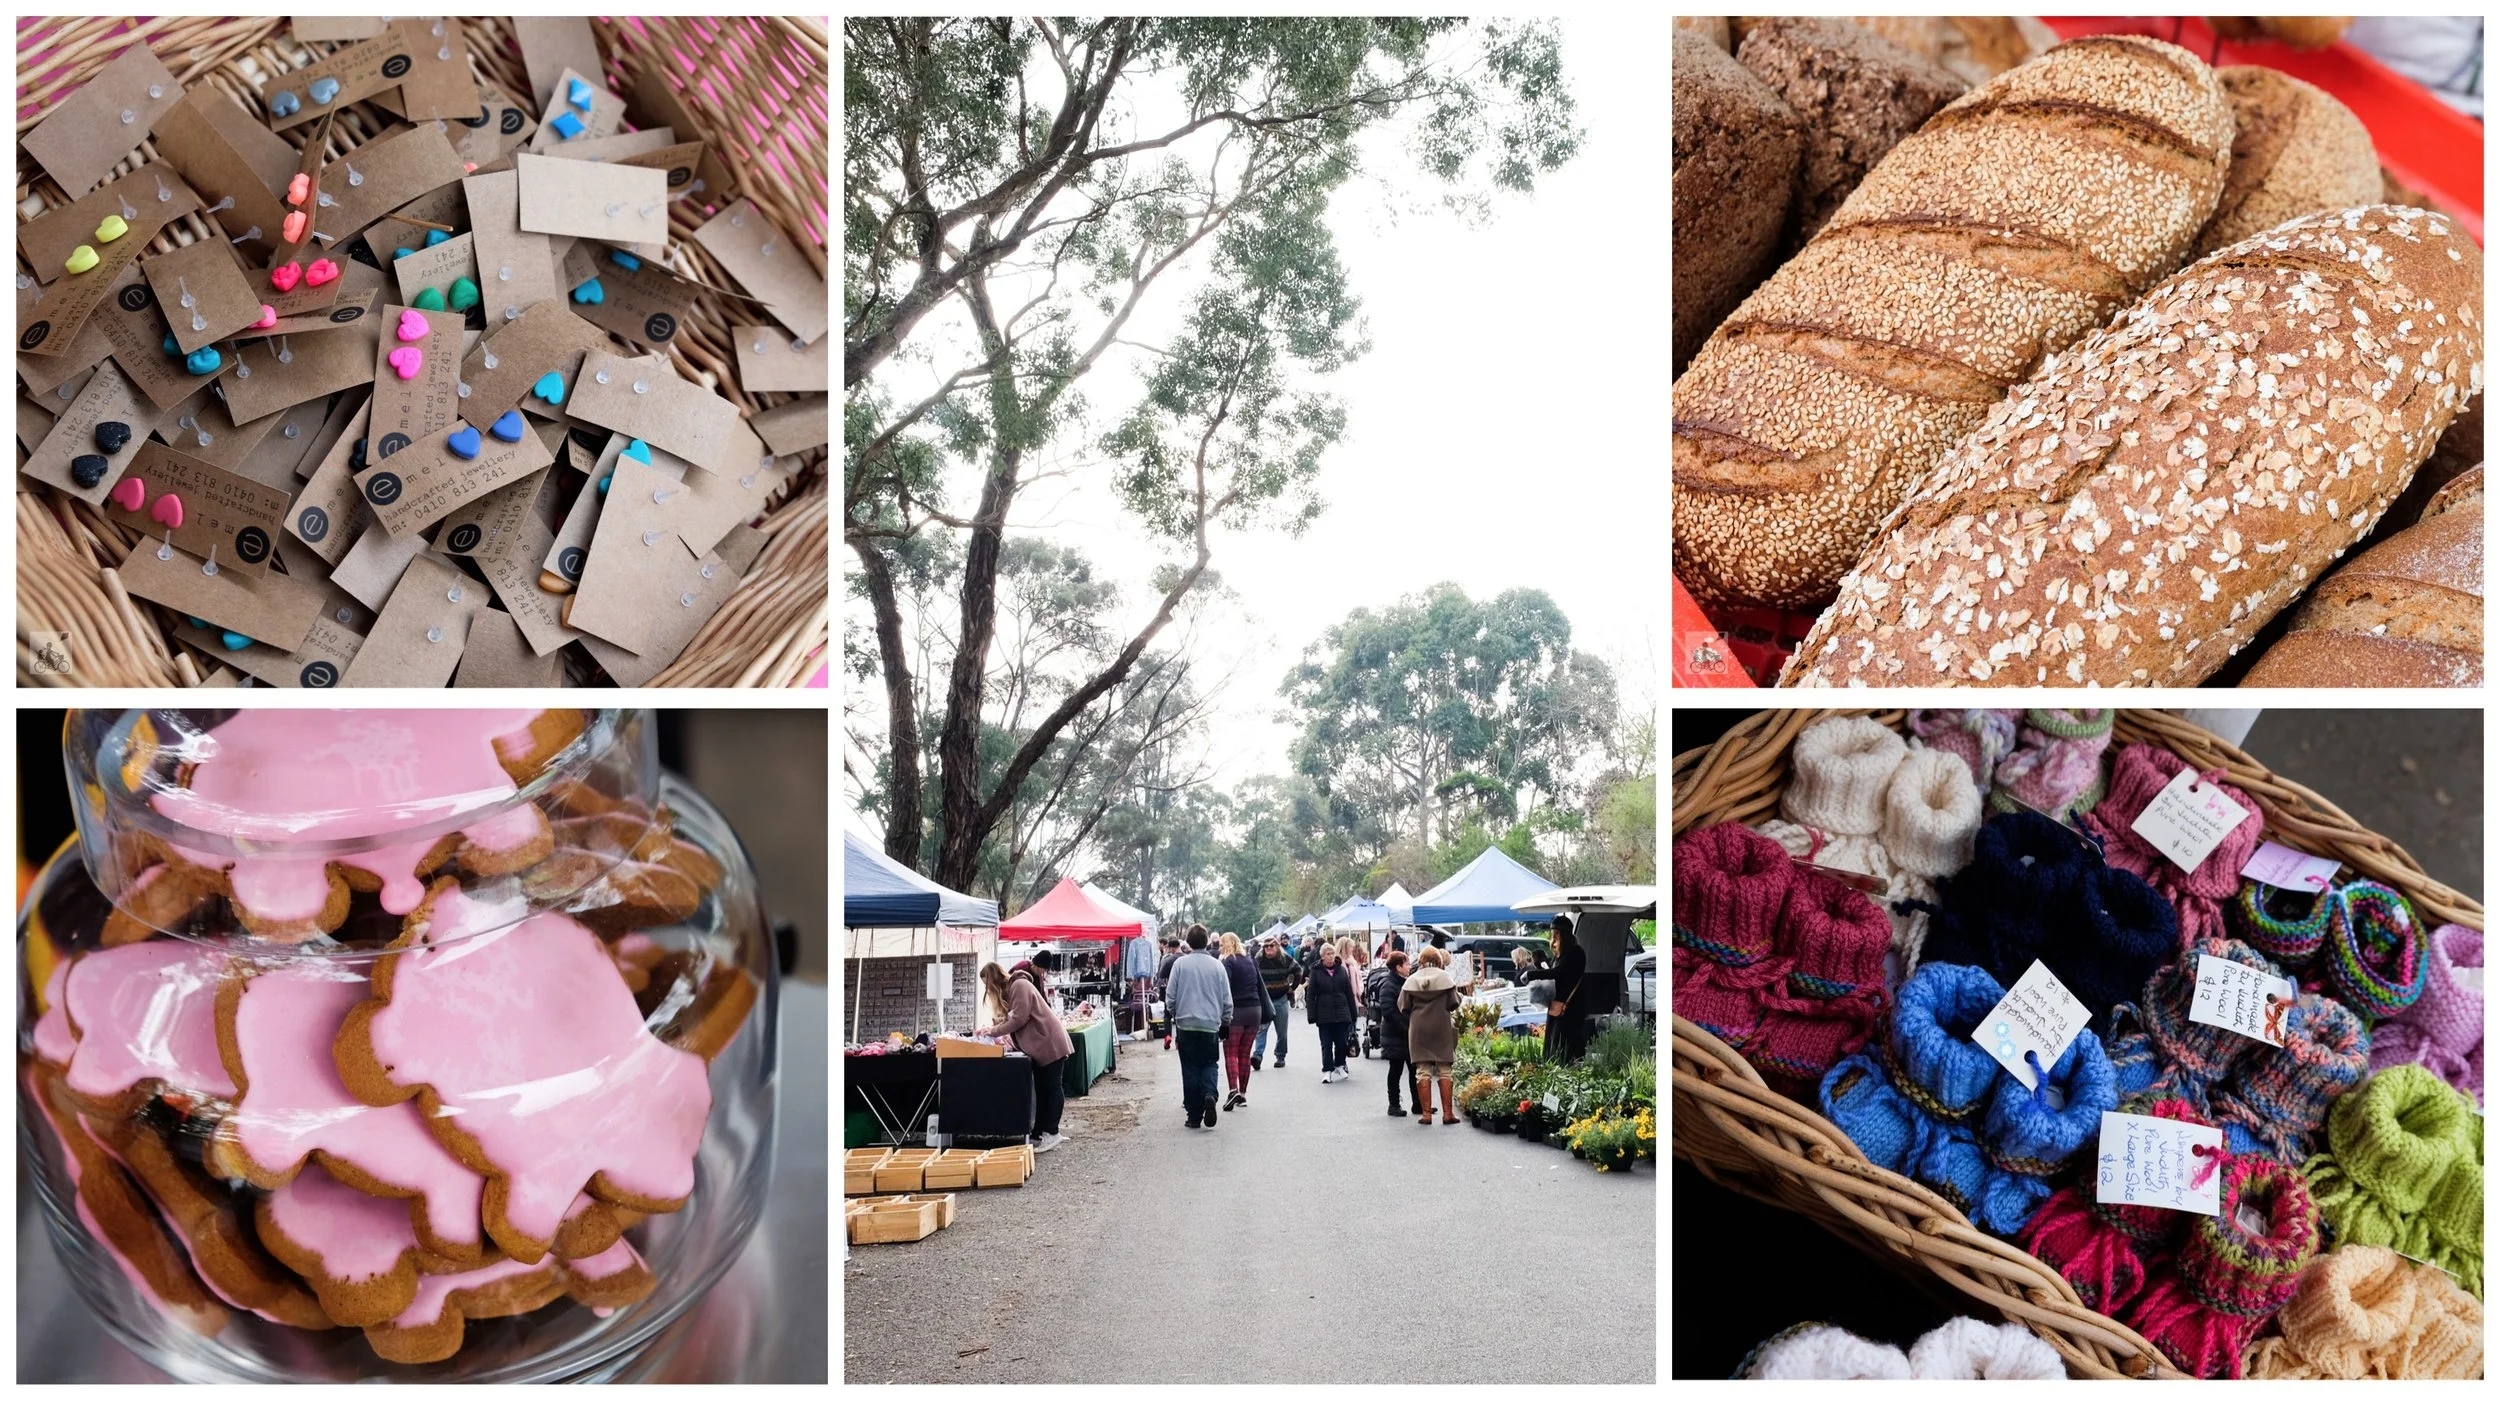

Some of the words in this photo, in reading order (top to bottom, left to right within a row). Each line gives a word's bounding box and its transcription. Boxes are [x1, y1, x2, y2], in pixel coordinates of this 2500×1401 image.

[435, 248, 455, 263] 241
[104, 324, 126, 348] 0410
[427, 331, 441, 388] jewellery
[441, 351, 452, 373] 241
[100, 369, 119, 389] 410
[438, 382, 448, 404] 813
[81, 393, 100, 413] 813
[62, 417, 82, 437] 241
[145, 465, 200, 495] jewellery
[166, 460, 188, 477] 241
[194, 472, 217, 488] 813
[224, 483, 255, 503] 0410
[383, 477, 455, 523] handcrafted
[460, 450, 516, 480] jewellery
[391, 521, 407, 534] m:
[415, 495, 446, 519] 0410
[452, 480, 477, 497] 813
[483, 467, 506, 482] 241
[205, 491, 276, 525] handcrafted
[503, 505, 521, 532] 0410
[520, 479, 534, 499] 813
[497, 568, 516, 590] 813
[514, 595, 533, 617] 241
[515, 577, 554, 626] jewellery
[2155, 806, 2175, 824] Pure
[2168, 787, 2223, 833] Handmade
[2012, 990, 2046, 1028] Judith
[2233, 989, 2249, 1027] Judith
[2247, 972, 2266, 1033] Handmade
[1999, 1001, 2056, 1058] Handmade
[2048, 1006, 2068, 1032] Pure
[2123, 1134, 2140, 1170] Large
[2144, 1128, 2160, 1156] Pure
[2143, 1160, 2157, 1193] Wool
[2158, 1140, 2175, 1190] Judith
[2125, 1172, 2141, 1201] Size
[2171, 1186, 2188, 1206] by
